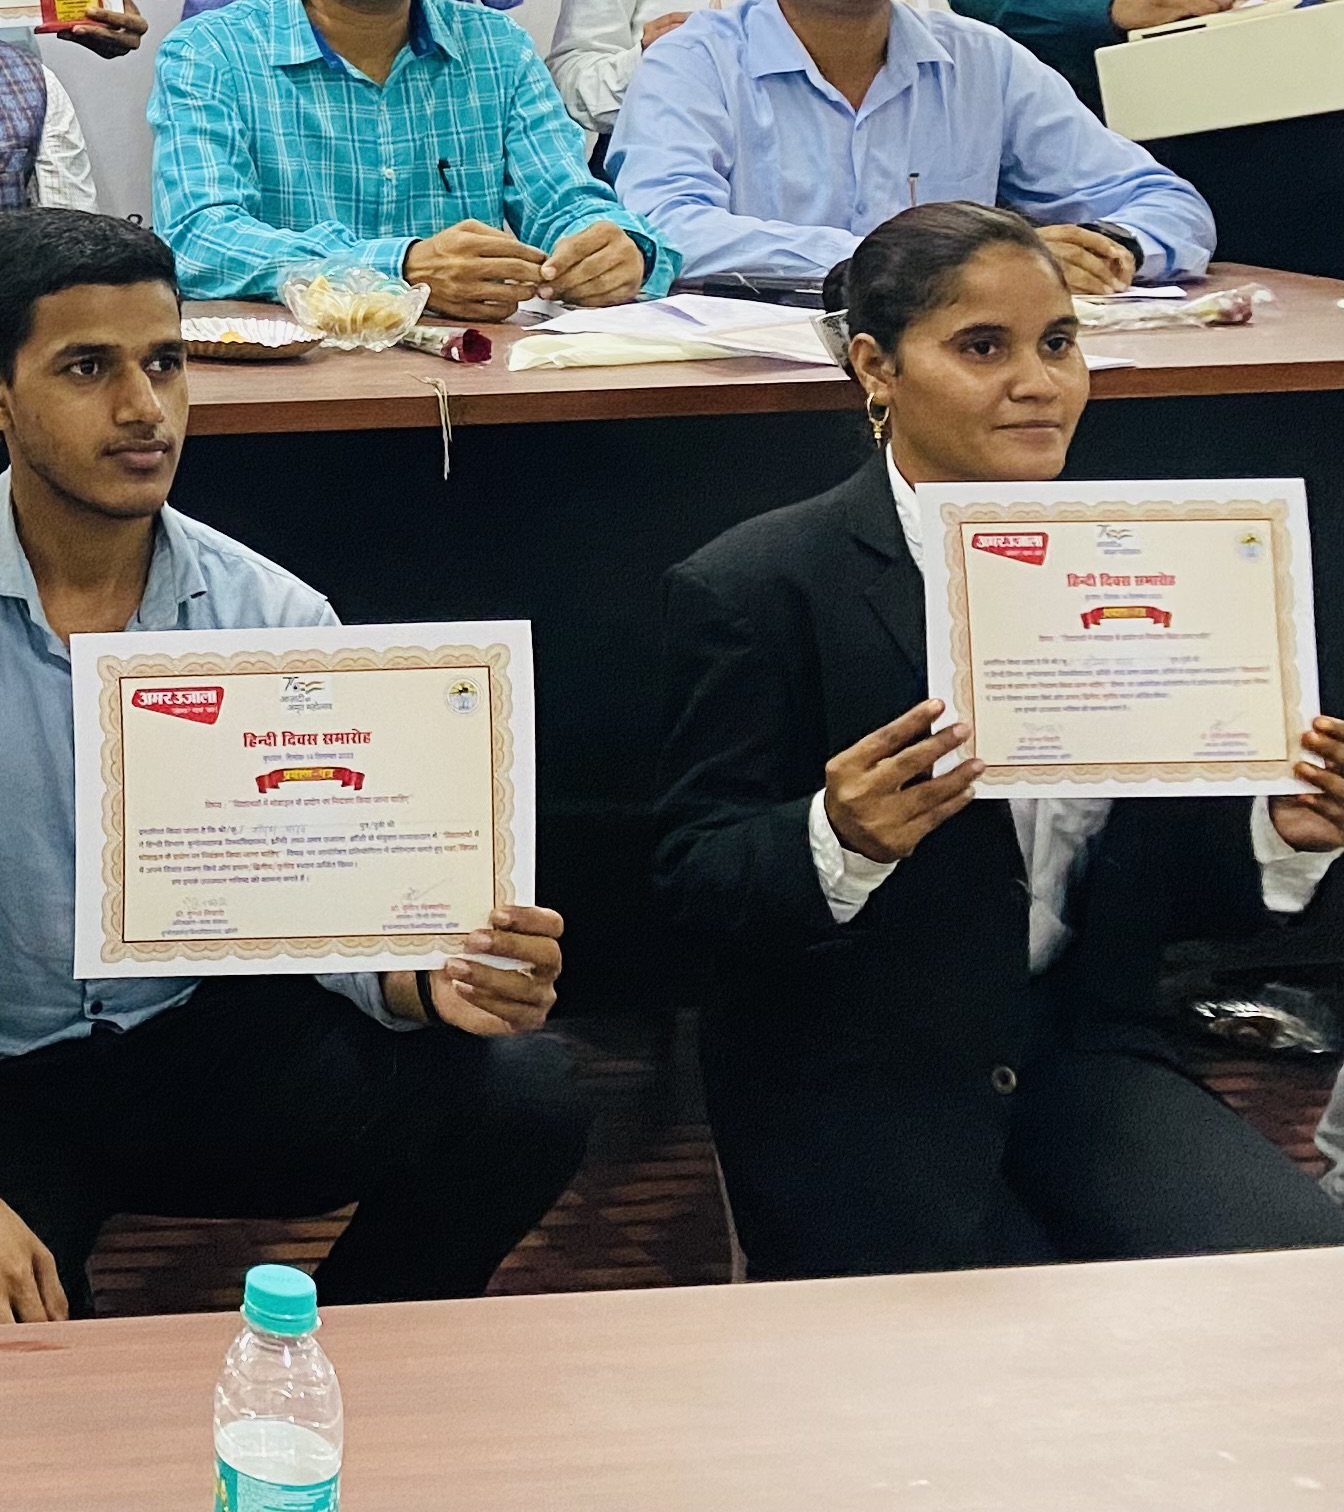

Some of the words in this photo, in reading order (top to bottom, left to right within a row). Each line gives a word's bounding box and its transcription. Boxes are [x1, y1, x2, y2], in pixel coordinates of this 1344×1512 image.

[138, 691, 172, 705] अमर
[173, 689, 216, 704] उजाला
[243, 731, 276, 747] हिन्दी
[282, 730, 317, 746] दिवस
[322, 728, 371, 745] समारोह
